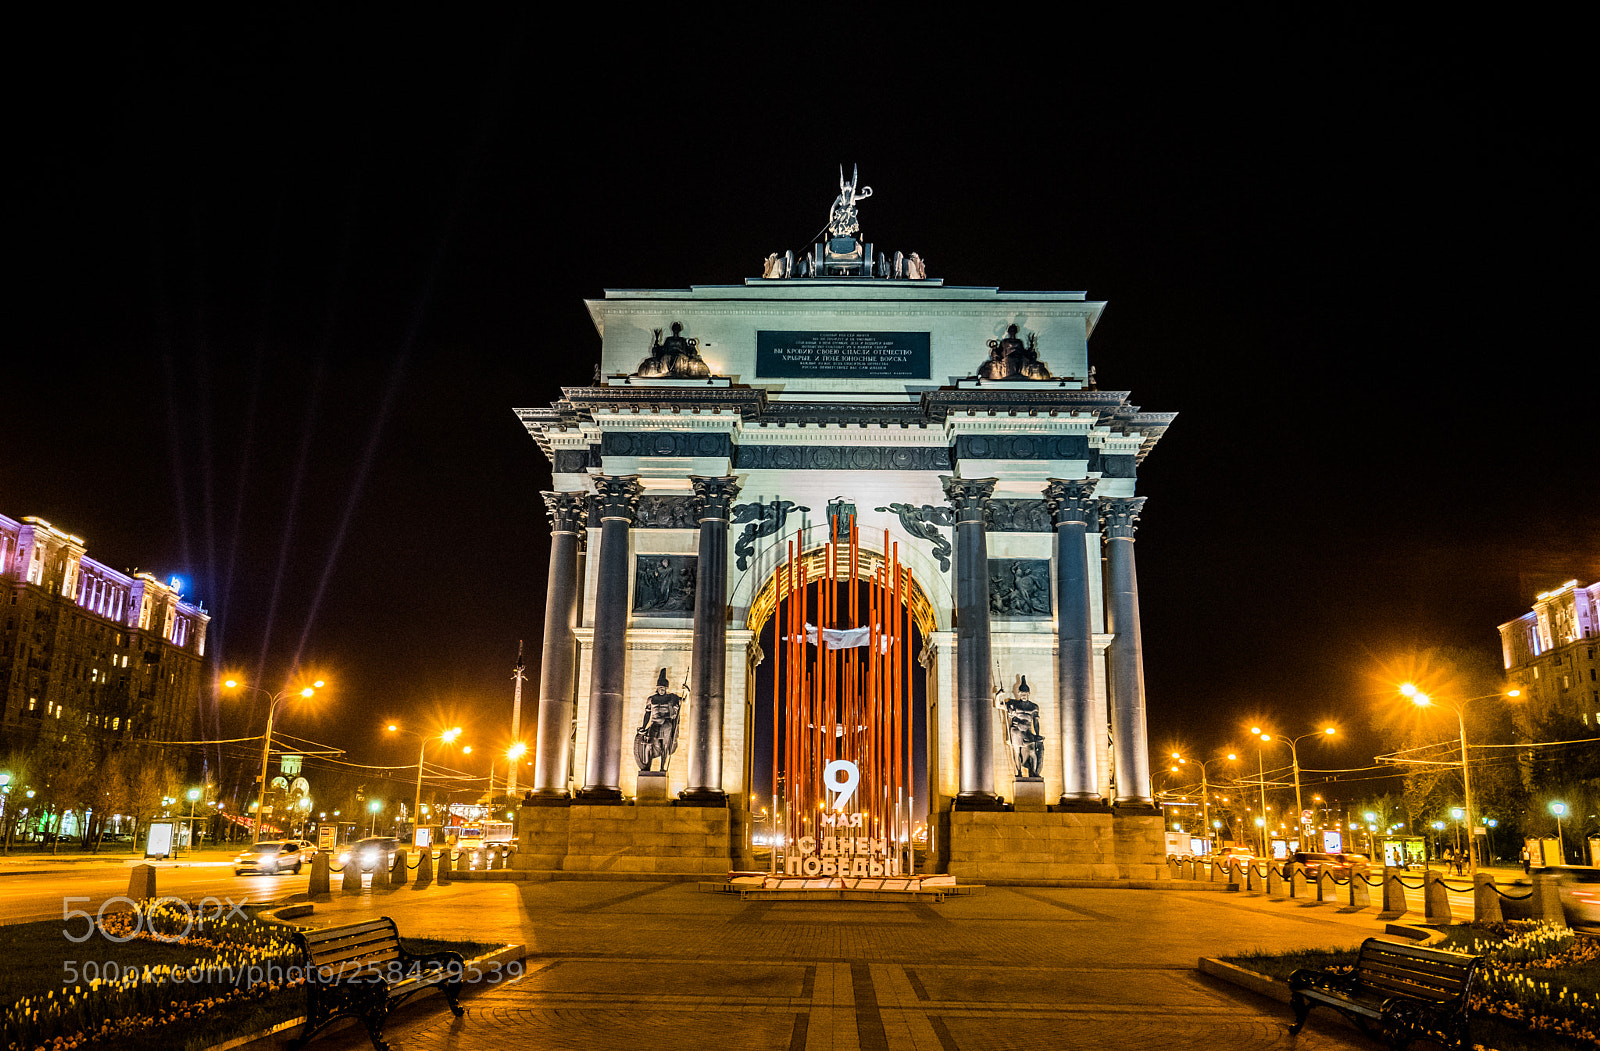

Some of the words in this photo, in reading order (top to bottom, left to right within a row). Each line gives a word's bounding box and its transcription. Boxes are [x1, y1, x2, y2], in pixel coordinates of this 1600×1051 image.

[823, 759, 860, 810] 9
[821, 812, 863, 828] МАЯ
[798, 835, 816, 854] С
[822, 836, 887, 856] ДНЕМ
